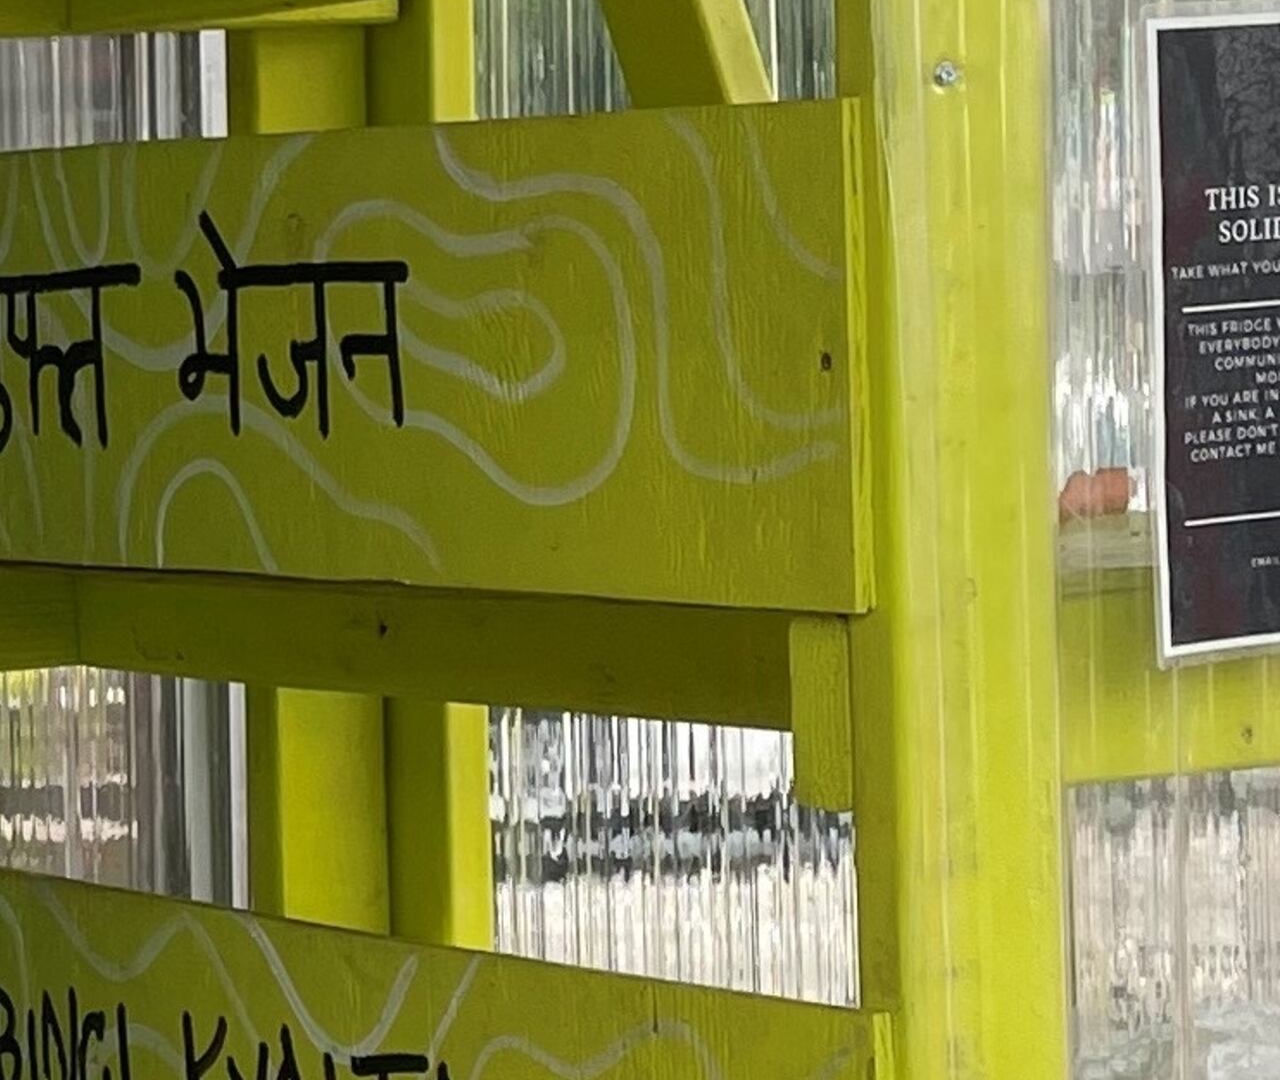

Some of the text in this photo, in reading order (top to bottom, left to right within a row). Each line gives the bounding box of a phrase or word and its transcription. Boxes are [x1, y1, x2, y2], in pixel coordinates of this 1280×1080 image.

[1204, 185, 1261, 211] THIS
[1171, 264, 1205, 280] TAKE
[1208, 261, 1248, 278] WHAT
[1187, 322, 1218, 336] THIS
[1222, 317, 1272, 333] FRIDGE
[1199, 336, 1280, 355] EVERYBODY
[1255, 370, 1280, 385] MO
[1185, 395, 1197, 409] IF
[1202, 392, 1229, 407] YOU
[1233, 389, 1259, 404] ARE
[1212, 411, 1222, 424] A
[1265, 406, 1276, 419] A
[1184, 428, 1233, 445] PLEASE
[1190, 441, 1276, 463] CONTACT ME
